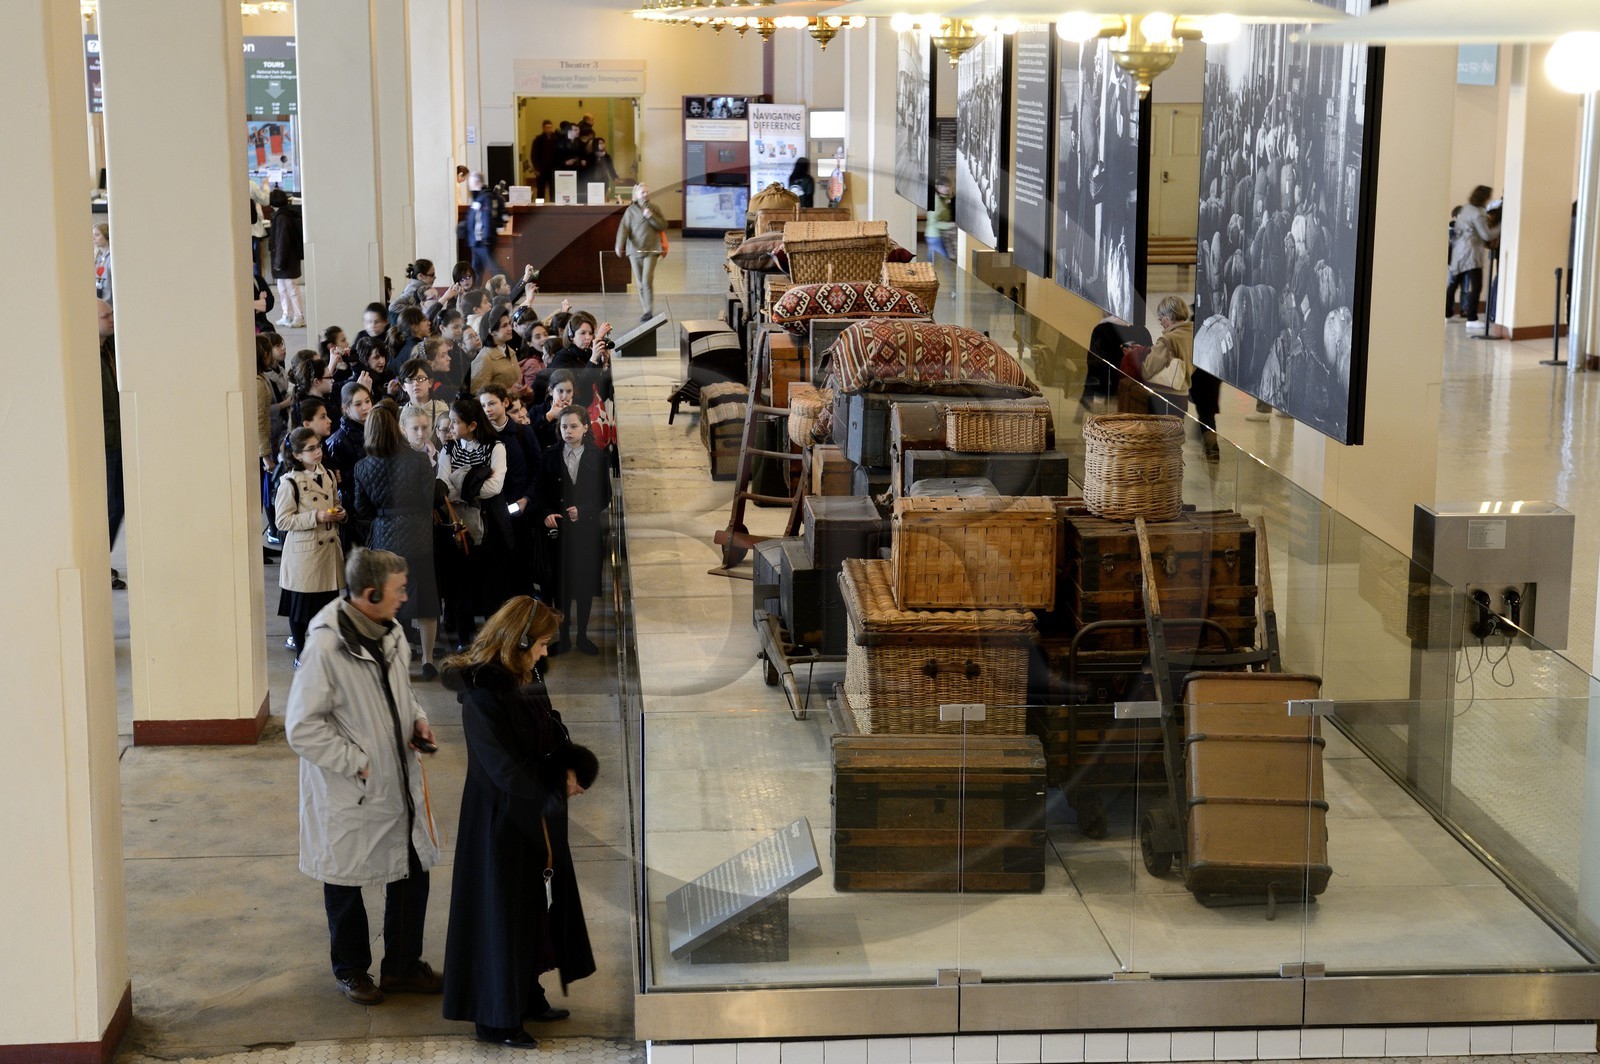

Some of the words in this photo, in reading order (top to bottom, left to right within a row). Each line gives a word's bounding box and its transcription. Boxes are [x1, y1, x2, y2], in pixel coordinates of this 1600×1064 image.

[560, 61, 590, 69] Theater
[592, 61, 599, 69] 3
[598, 75, 638, 83] Immigration
[752, 109, 801, 120] NAVIGATING
[753, 122, 800, 133] DIFFERENCE
